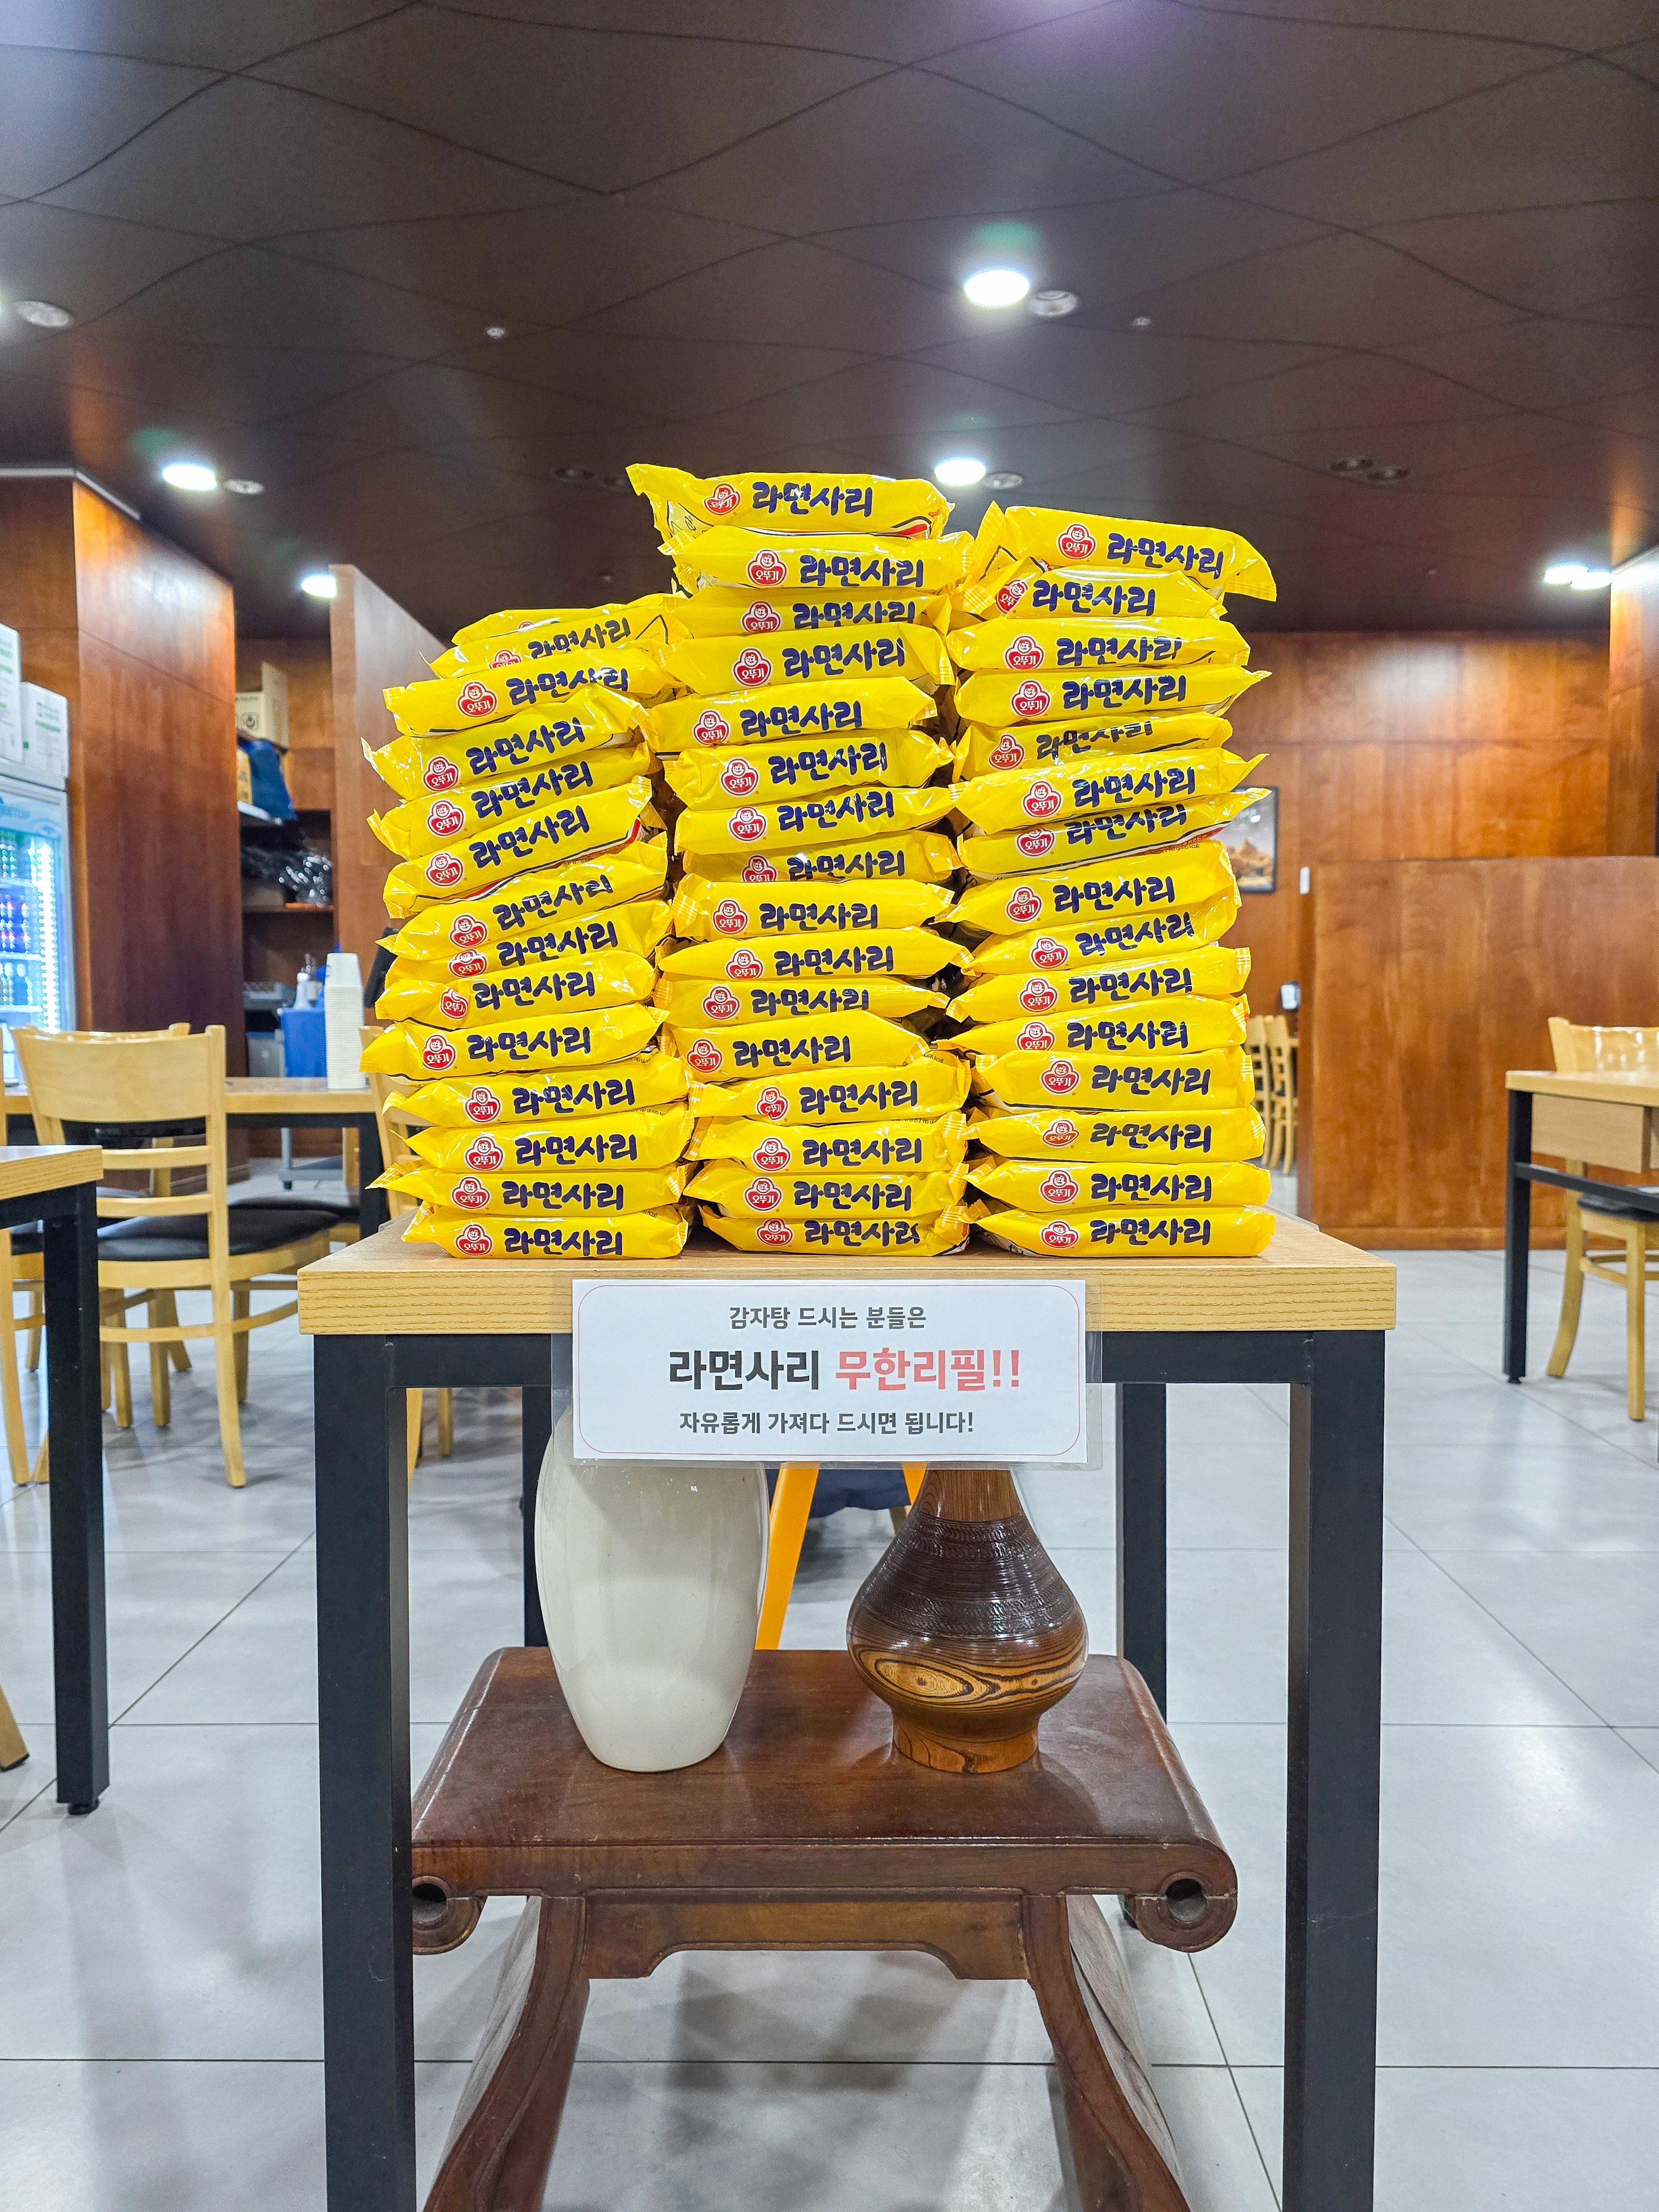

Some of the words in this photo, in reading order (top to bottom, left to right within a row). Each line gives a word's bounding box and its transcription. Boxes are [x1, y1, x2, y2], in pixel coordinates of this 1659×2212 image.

[753, 482, 872, 517] 라면사리
[756, 571, 779, 580] 오뚜기
[800, 555, 923, 587] 라면사리
[1065, 542, 1088, 554] 오뚜기
[1107, 533, 1223, 579] 라면사리
[1000, 594, 1019, 609] 오뚜
[1032, 580, 1155, 616] 라면사리
[793, 601, 915, 629] 라면사리
[742, 668, 764, 679] 오뚜기
[782, 638, 905, 679] 라면사리
[1013, 655, 1036, 665] 오뚜기
[1057, 637, 1181, 666] 라면사리
[467, 701, 491, 712] 오뚜기
[1020, 700, 1042, 710] 오뚜기
[1062, 675, 1186, 710] 라면사리
[702, 729, 723, 741] 오뚜기
[740, 701, 861, 737] 라면사리
[431, 772, 453, 787] 오뚜기
[466, 717, 585, 775] 라면사리
[729, 777, 751, 789] 오뚜기
[768, 742, 887, 785] 라면사리
[995, 753, 1017, 763] 오뚜기
[436, 818, 459, 831] 오뚜기
[471, 761, 593, 818] 라면사리
[1031, 800, 1054, 811] 오뚜기
[1073, 767, 1195, 807] 라면사리
[737, 823, 759, 834] 오뚜기
[777, 791, 894, 832] 라면사리
[1025, 839, 1047, 850] 오뚜기
[1066, 803, 1186, 845] 라면사리
[436, 868, 459, 880] 오뚜기
[469, 805, 590, 868] 라면사리
[787, 850, 905, 881] 라면사리
[460, 930, 482, 944] 오뚜기
[493, 875, 614, 930] 라면사리
[1013, 904, 1034, 915] 오뚜기
[1053, 876, 1175, 913] 라면사리
[759, 903, 878, 931] 라면사리
[459, 963, 481, 974] 오뚜기
[496, 921, 617, 966] 라면사리
[1040, 952, 1062, 964] 오뚜기
[1074, 911, 1194, 956] 라면사리
[735, 968, 756, 977] 오뚜기
[774, 946, 893, 977] 라면사리
[473, 972, 595, 1010] 라면사리
[711, 1004, 732, 1013] 오뚜기
[751, 988, 869, 1016] 라면사리
[1028, 996, 1050, 1006] 오뚜기
[1069, 968, 1192, 1004] 라면사리
[427, 1053, 449, 1064] 오뚜기
[467, 1027, 590, 1062] 라면사리
[695, 1057, 716, 1066] 오뚜기
[733, 1036, 850, 1068] 라면사리
[1025, 1040, 1047, 1049] 오뚜기
[1067, 1021, 1188, 1051] 라면사리
[1048, 1077, 1071, 1086] 오뚜기
[1092, 1065, 1211, 1095] 라면사리
[473, 1106, 493, 1115] 오뚜기
[512, 1079, 635, 1116] 라면사리
[800, 1081, 917, 1115] 라면사리
[473, 1156, 496, 1165] 오뚜기
[515, 1134, 637, 1166] 라면사리
[802, 1138, 921, 1167] 라면사리
[1090, 1124, 1211, 1152] 라면사리
[502, 1181, 623, 1210] 라면사리
[794, 1181, 911, 1211] 라면사리
[1091, 1174, 1211, 1202] 라면사리
[504, 1228, 622, 1256] 라면사리
[805, 1220, 920, 1246] 라면사리
[1048, 1235, 1070, 1243] 오뚜기
[1090, 1219, 1210, 1245] 라면사리
[730, 1307, 790, 1329] 감자탕
[798, 1307, 857, 1328] 드시는
[867, 1307, 926, 1329] 분들은
[670, 1350, 818, 1390] 라면사리
[836, 1348, 1018, 1390] 무한리필!!
[680, 1412, 760, 1434] 자유롭게
[768, 1413, 830, 1433] 가져다
[837, 1413, 896, 1434] 드시면
[905, 1412, 973, 1435] 됩니다!
